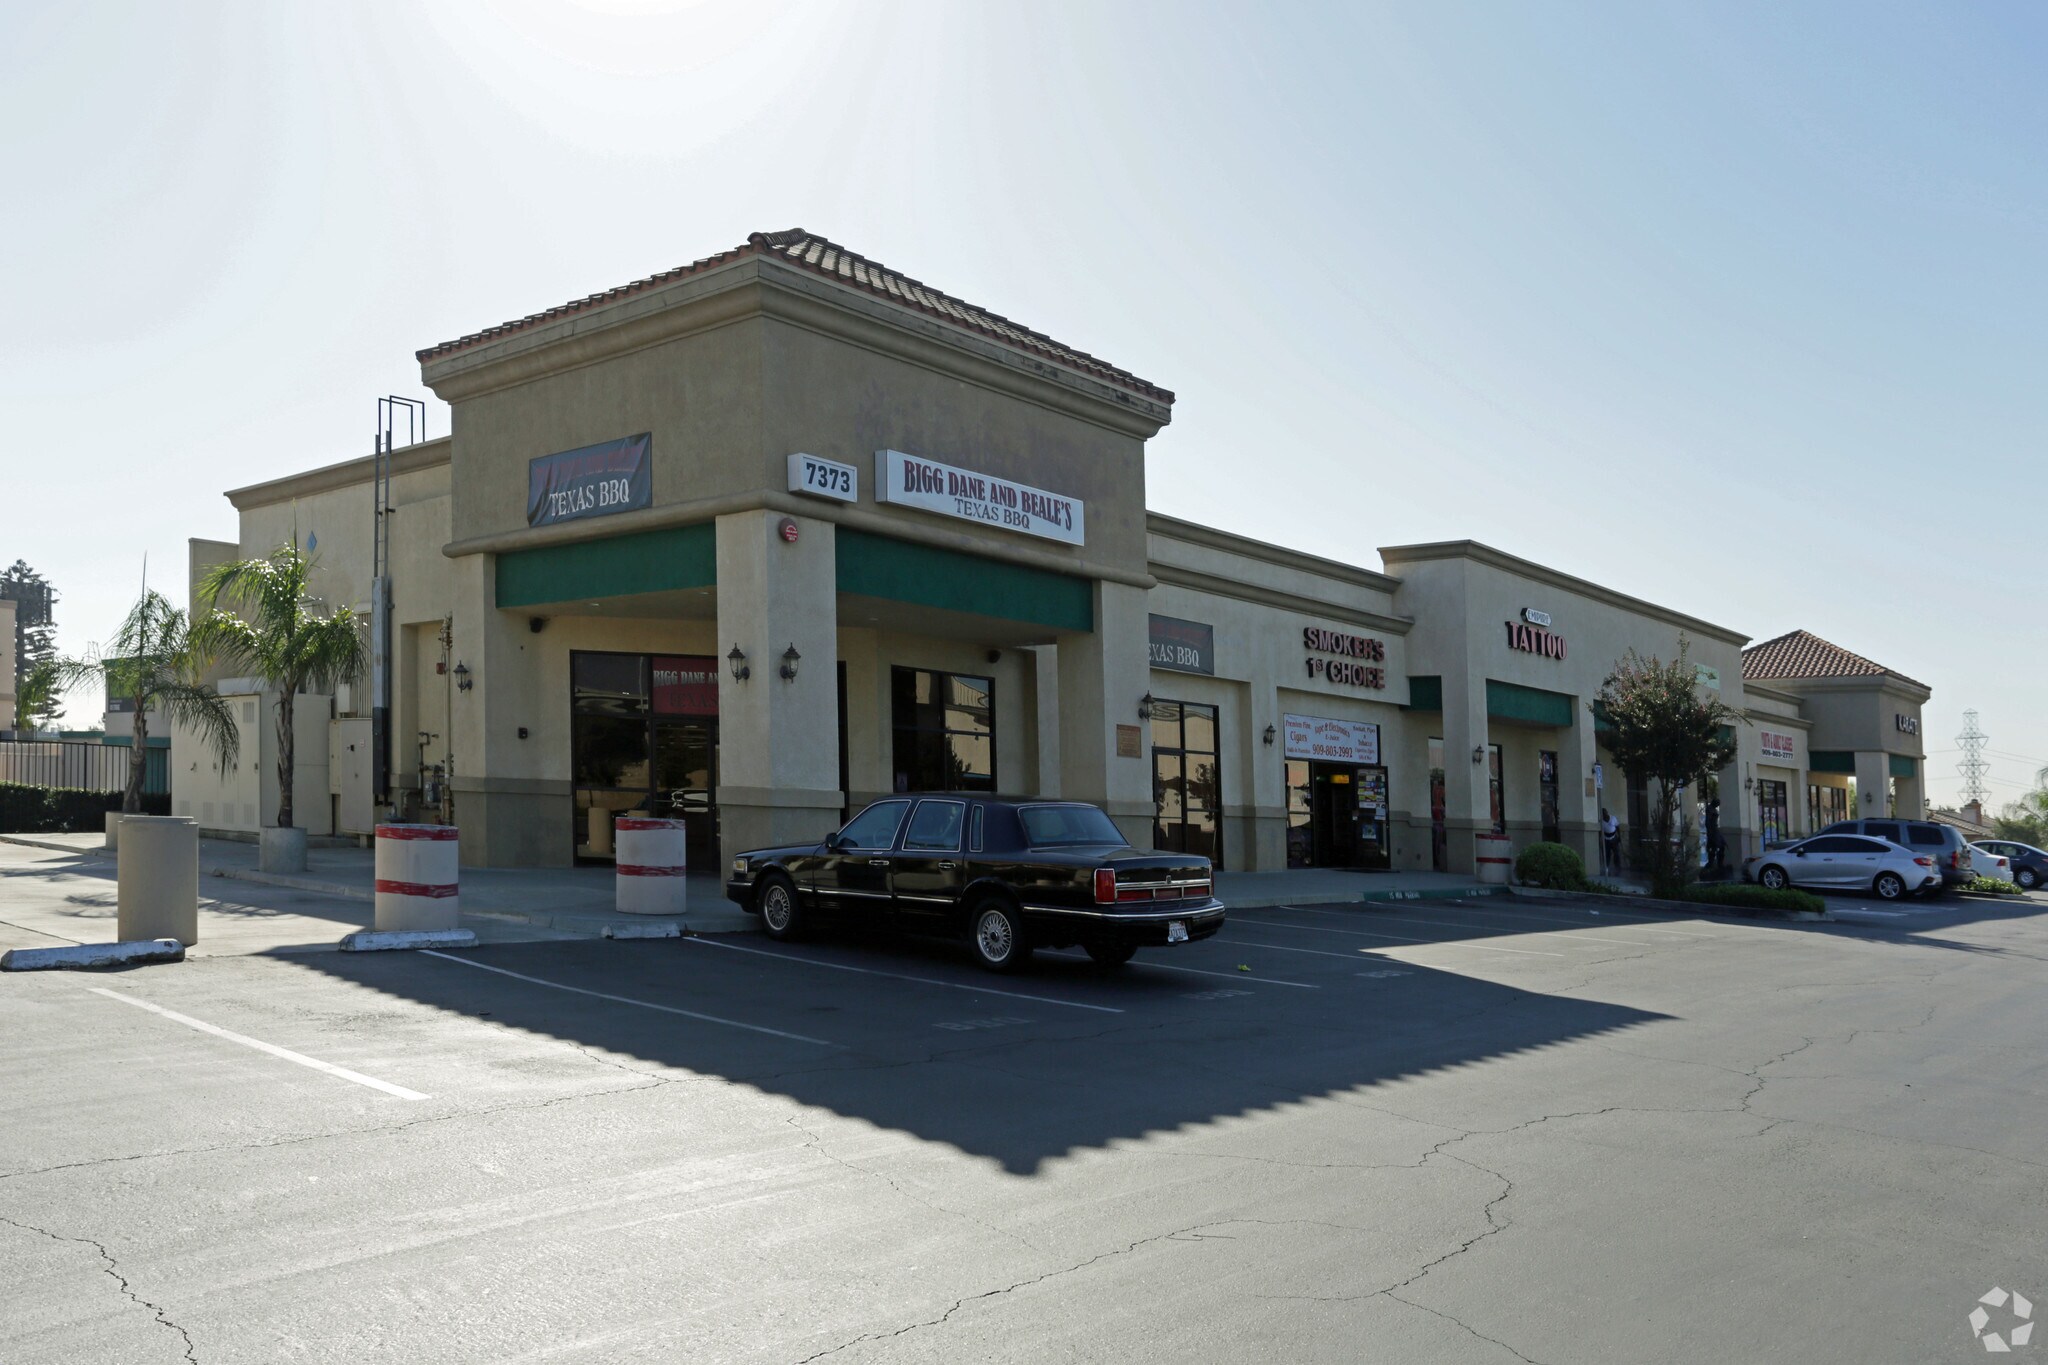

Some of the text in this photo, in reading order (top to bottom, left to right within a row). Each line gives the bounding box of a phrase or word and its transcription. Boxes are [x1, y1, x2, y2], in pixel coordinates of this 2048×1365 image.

[806, 462, 850, 493] 7373
[549, 479, 629, 516] TEXAS BBQ
[903, 459, 1072, 531] BIGG DANE AND BEALE'S
[954, 497, 1030, 530] TEXAS BBQ
[1528, 610, 1549, 624] EMPIRE
[1304, 627, 1385, 662] SMOKER'S
[1506, 621, 1568, 660] TATTOO
[1177, 646, 1200, 668] BBQ
[654, 671, 678, 687] BIGG
[681, 672, 705, 685] DANE
[1326, 660, 1385, 690] CHOICE
[1290, 731, 1307, 744] Cigars
